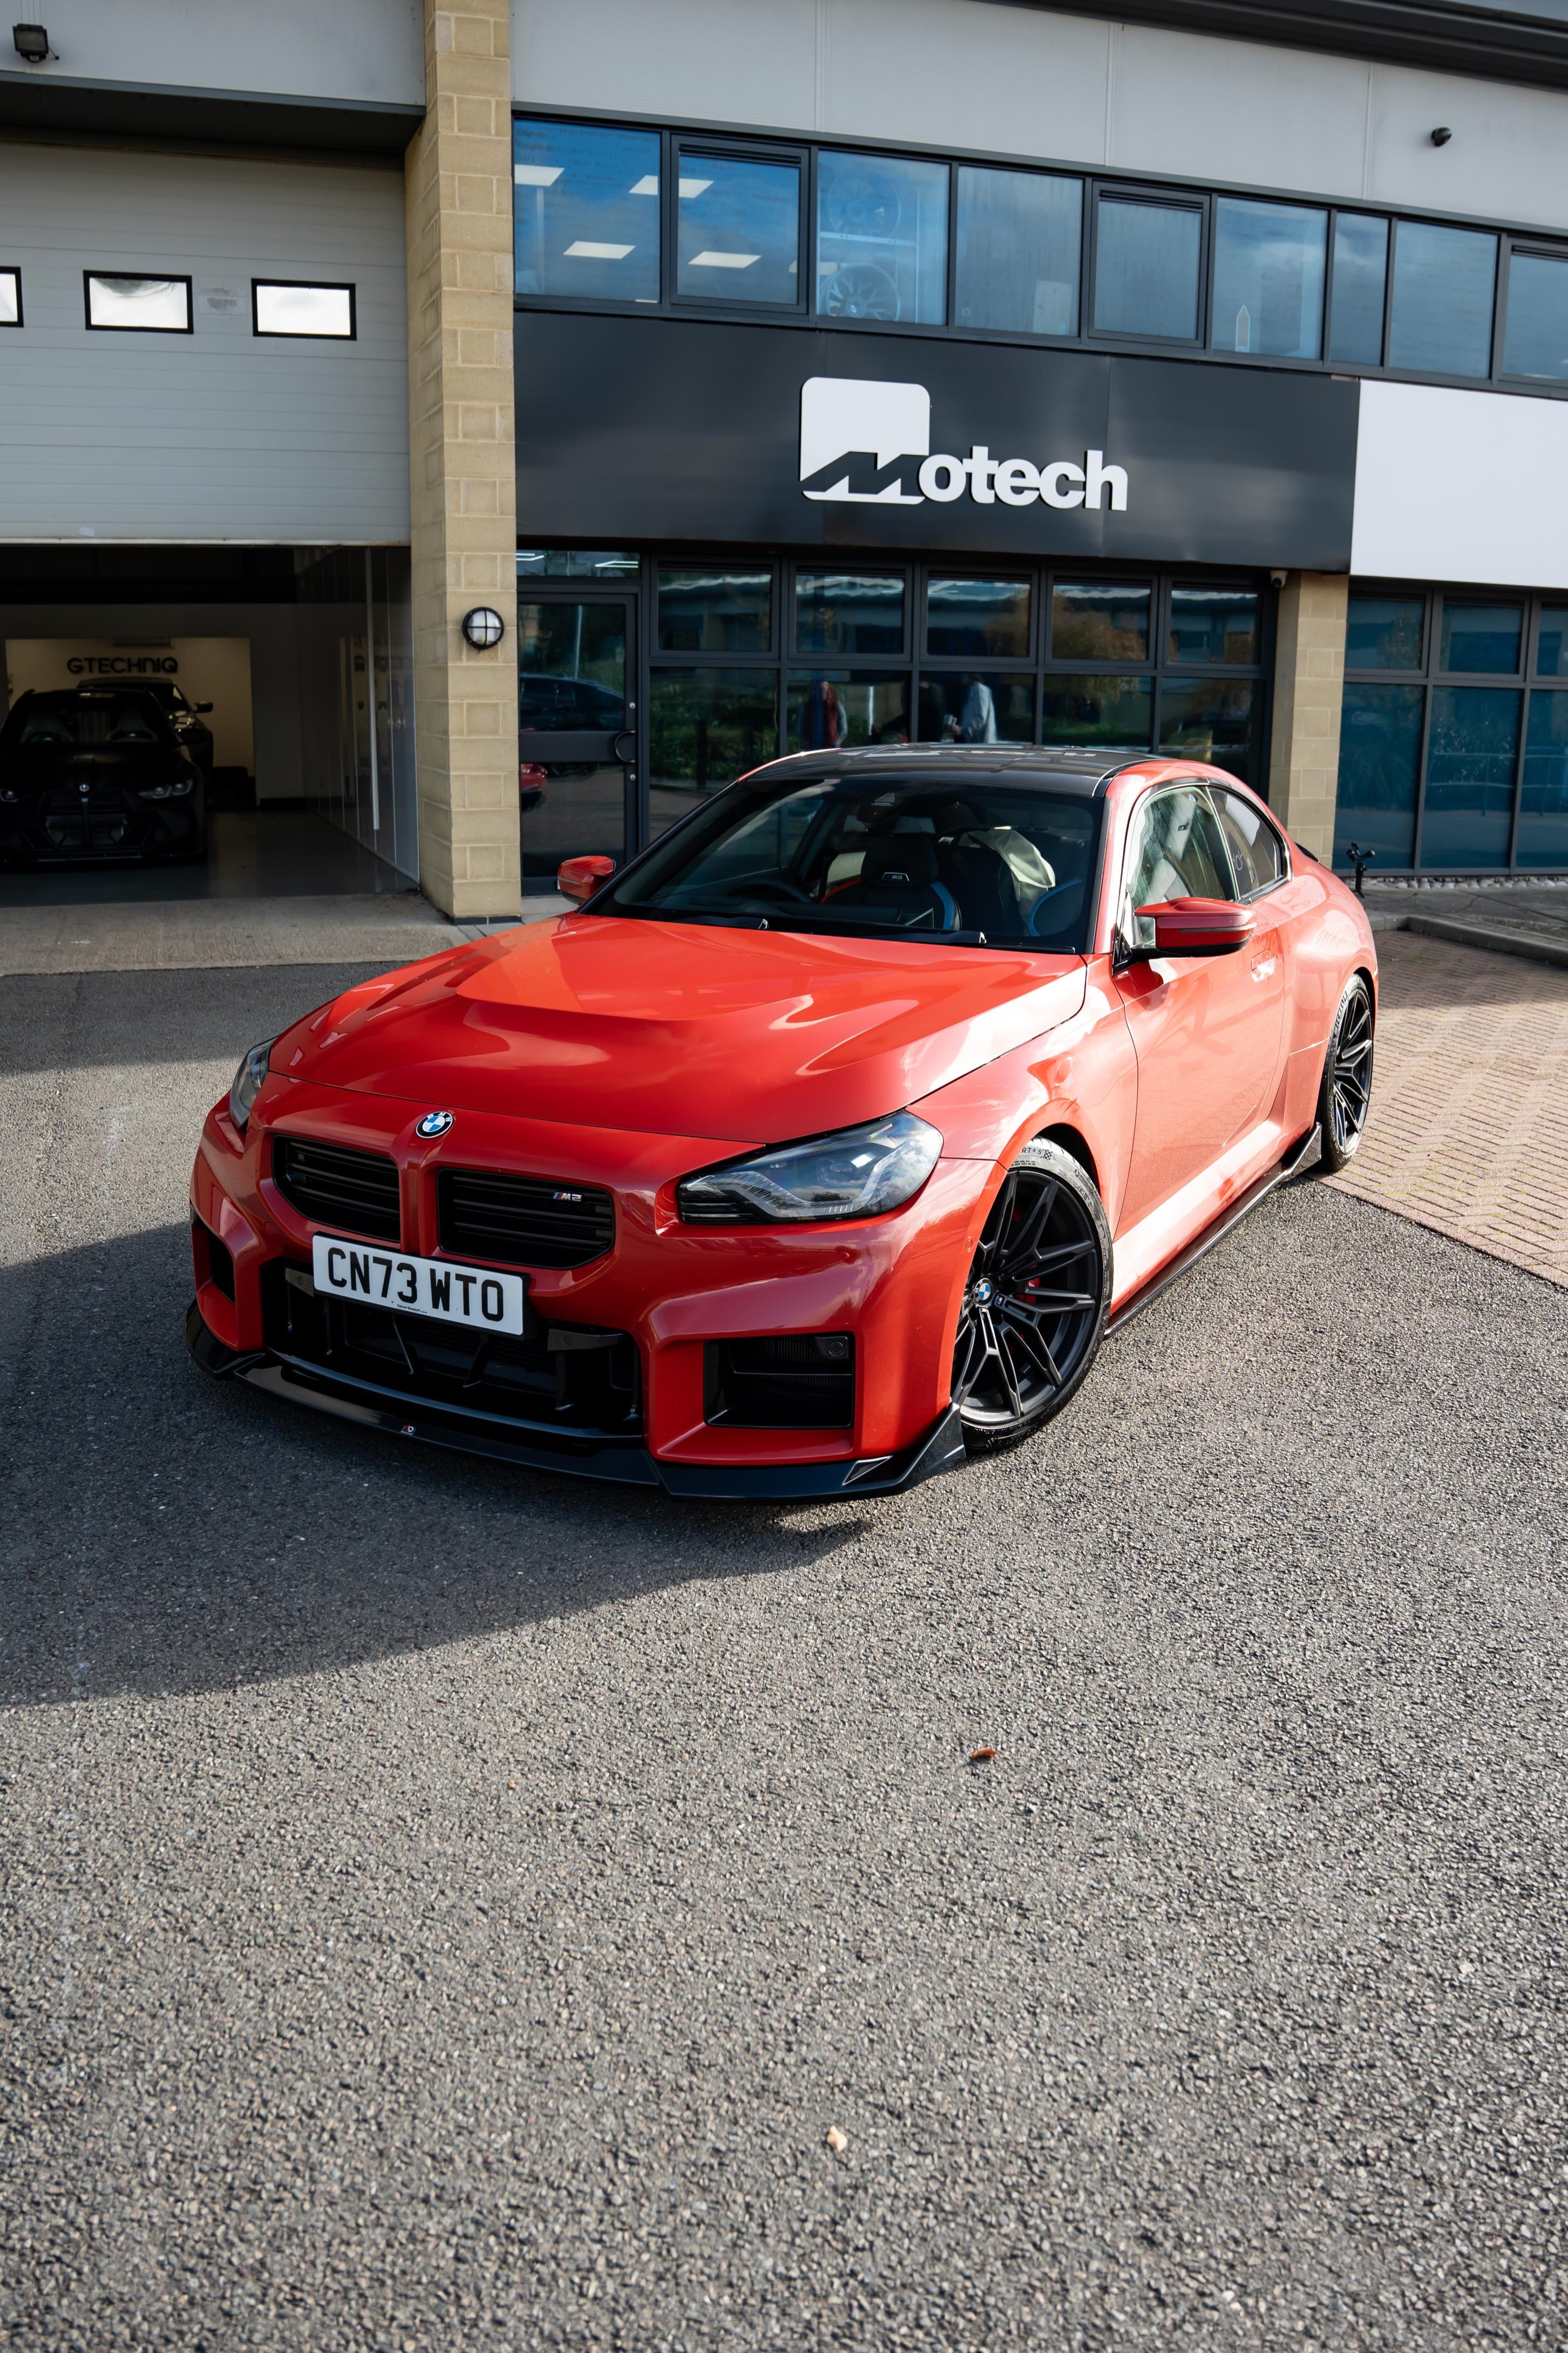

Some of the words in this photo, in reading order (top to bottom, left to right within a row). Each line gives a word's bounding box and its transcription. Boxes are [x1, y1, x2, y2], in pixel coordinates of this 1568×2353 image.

[66, 657, 179, 674] GTECHNIQ
[561, 1192, 582, 1202] M2
[328, 1247, 418, 1304] CN73
[430, 1268, 504, 1322] WTO
